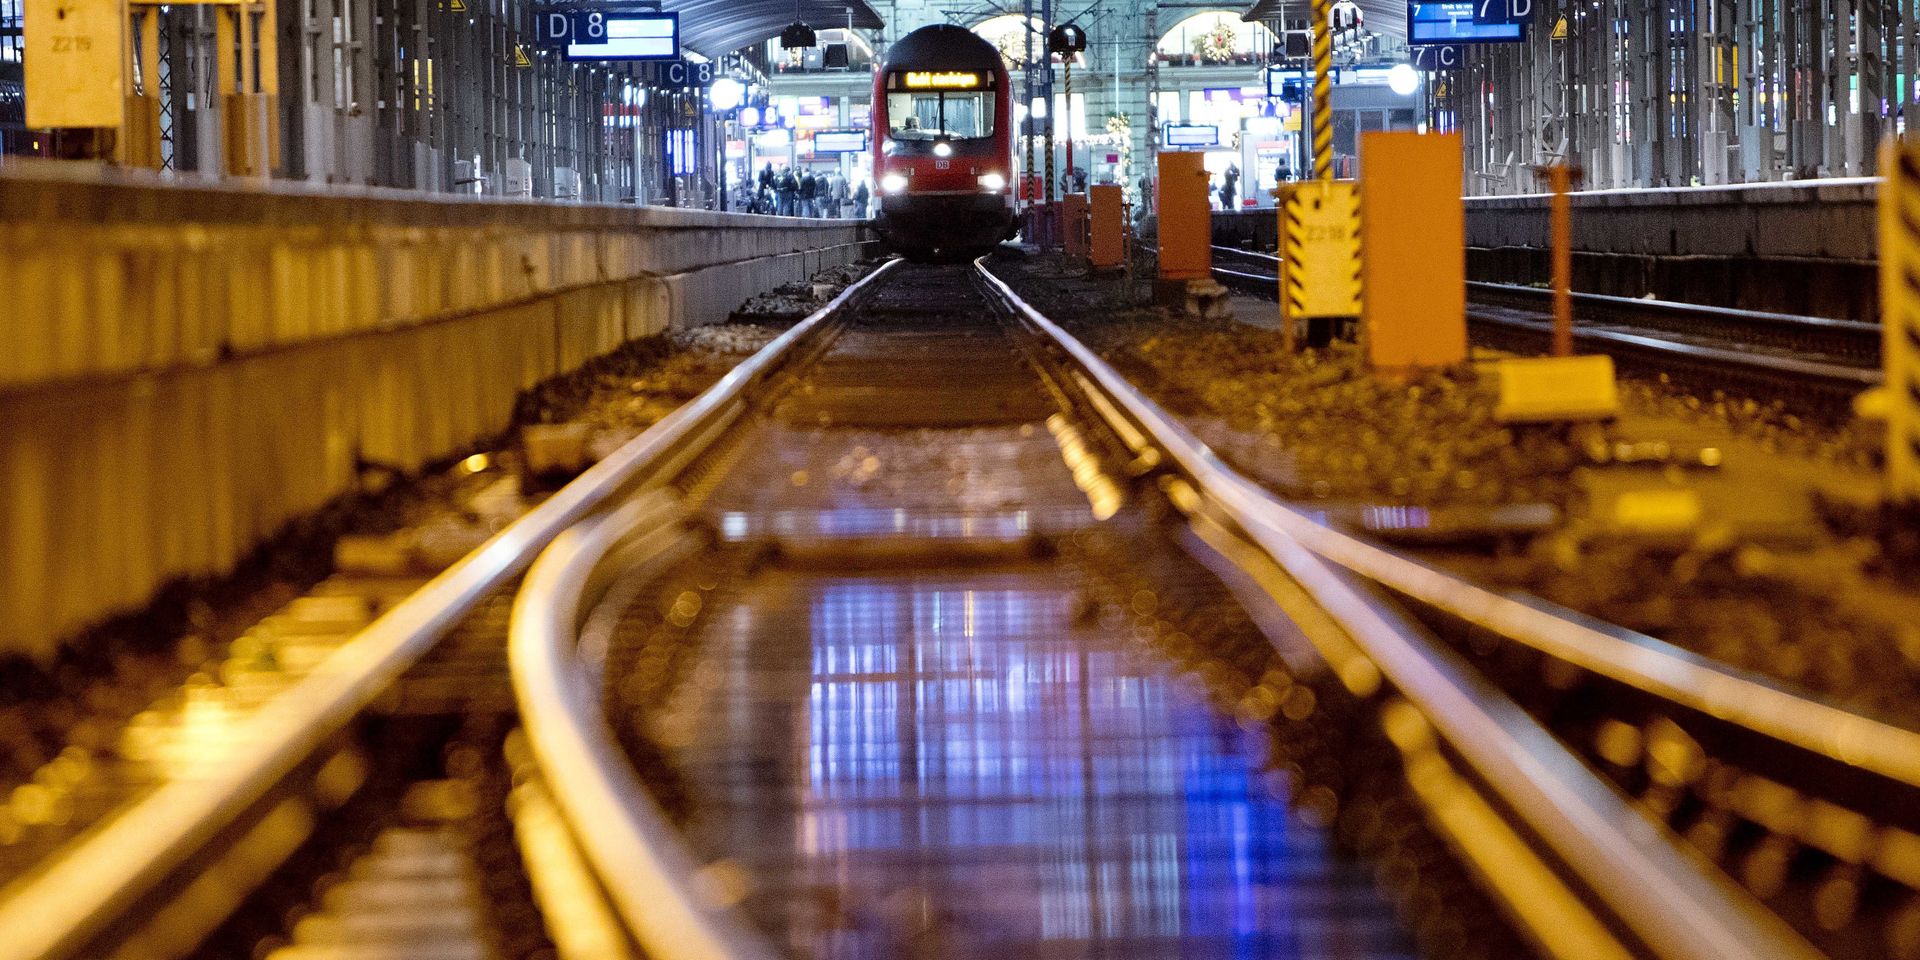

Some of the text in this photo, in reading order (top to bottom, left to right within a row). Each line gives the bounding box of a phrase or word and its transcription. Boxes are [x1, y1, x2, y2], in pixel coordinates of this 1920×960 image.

[1414, 4, 1421, 17] 7
[1513, 0, 1531, 17] D
[550, 12, 604, 38] D 8
[1413, 46, 1455, 66] 7 C
[669, 63, 711, 83] C 8
[936, 160, 949, 169] DB
